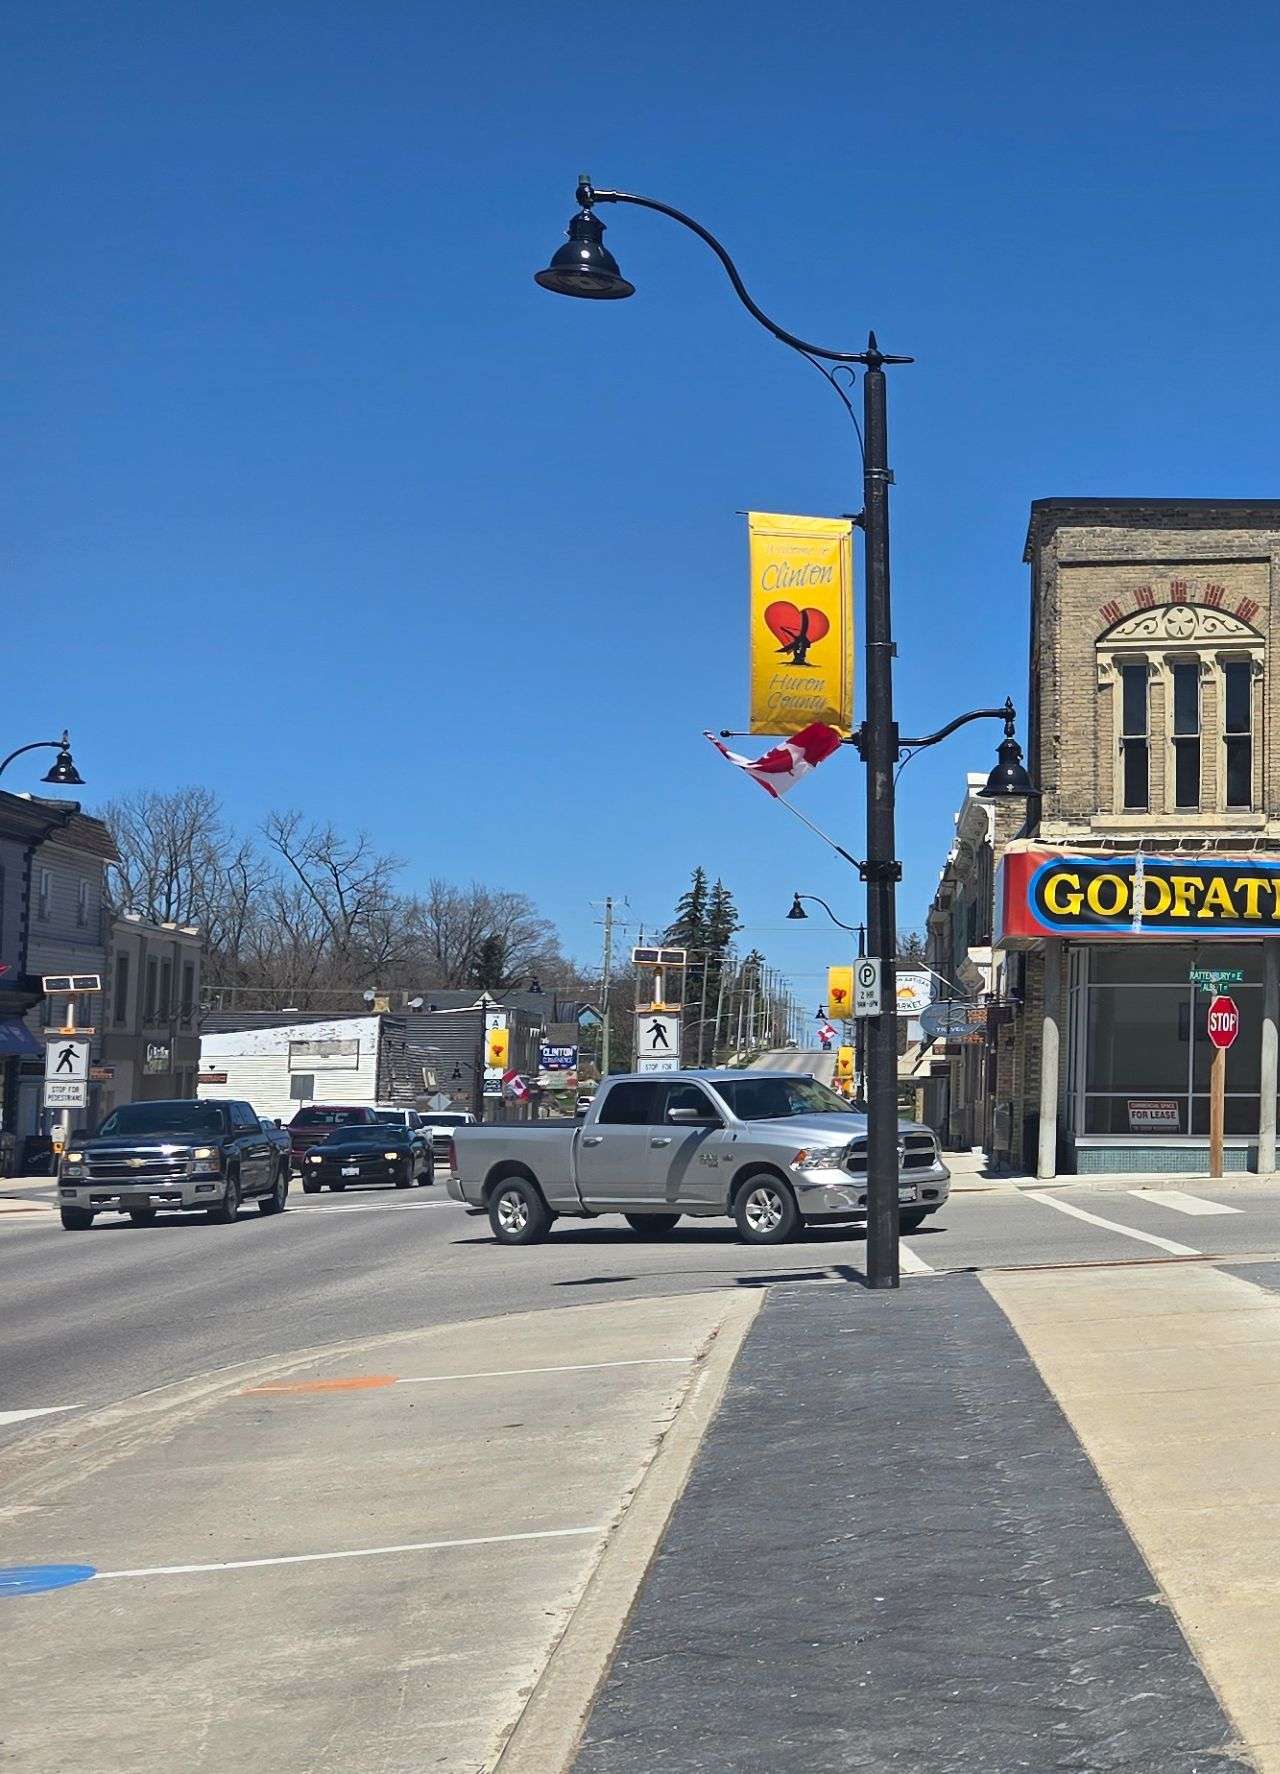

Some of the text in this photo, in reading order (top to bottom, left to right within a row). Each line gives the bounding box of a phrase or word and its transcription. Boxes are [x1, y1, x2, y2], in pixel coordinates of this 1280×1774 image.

[761, 561, 833, 591] Clinton
[769, 673, 825, 691] Huron
[768, 692, 827, 713] County
[863, 968, 872, 982] P
[1210, 1013, 1237, 1032] STOP
[542, 1047, 574, 1057] CLINTON
[1131, 1110, 1177, 1119] FOR LEASE
